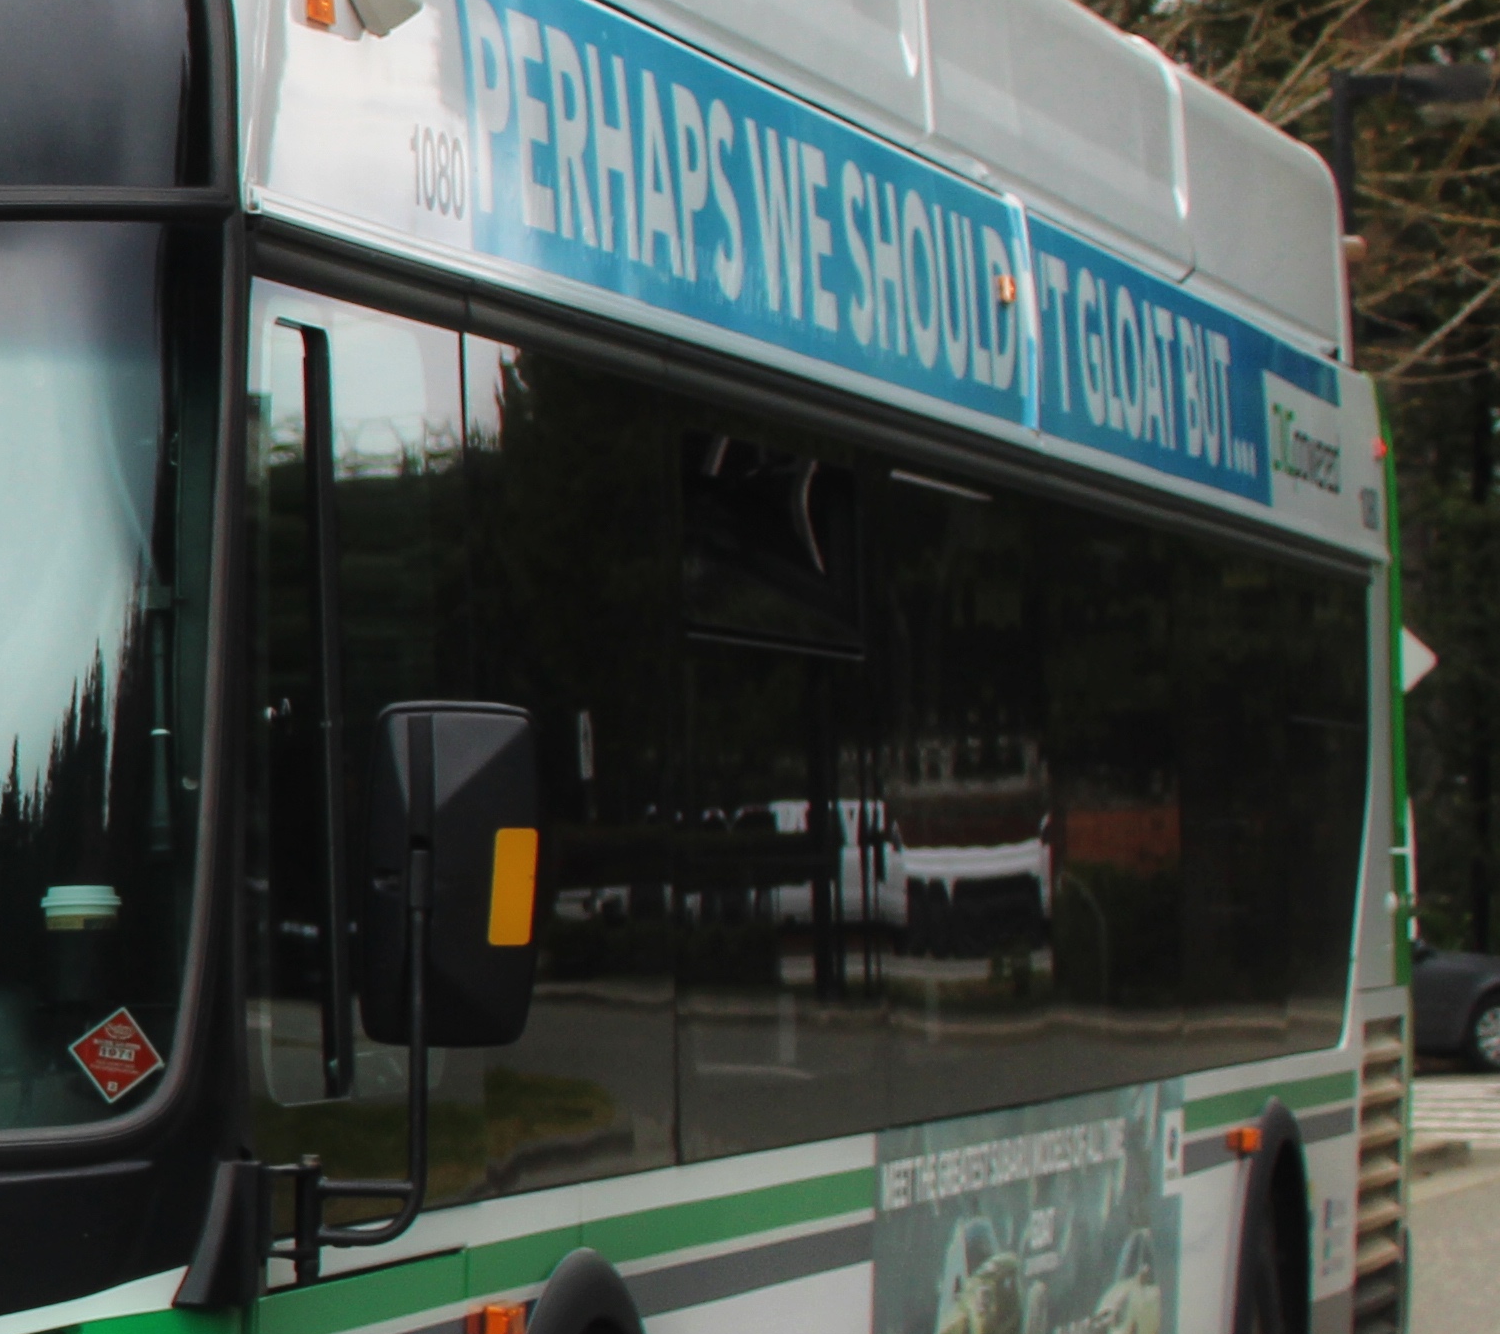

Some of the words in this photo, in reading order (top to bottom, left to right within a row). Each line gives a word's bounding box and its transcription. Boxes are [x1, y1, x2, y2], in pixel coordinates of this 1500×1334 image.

[411, 123, 468, 221] 1080
[744, 116, 839, 333] WE
[1075, 267, 1177, 451] GLOAT
